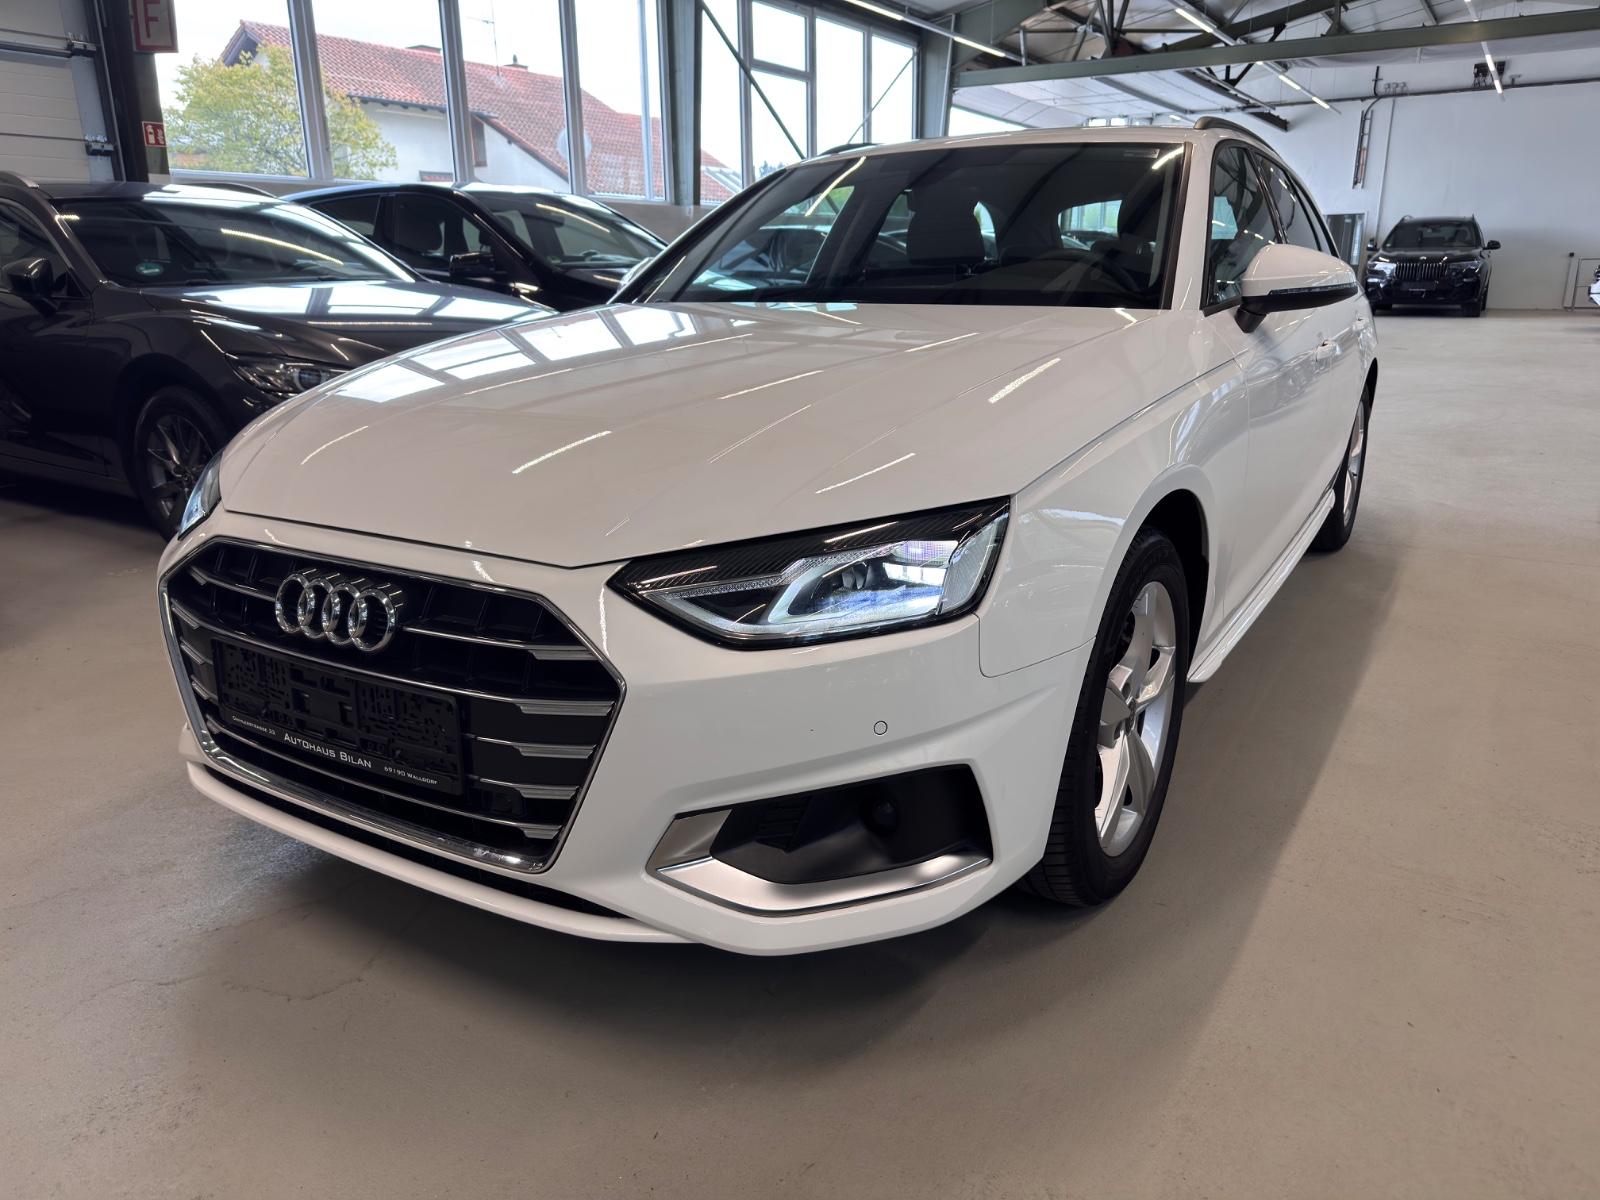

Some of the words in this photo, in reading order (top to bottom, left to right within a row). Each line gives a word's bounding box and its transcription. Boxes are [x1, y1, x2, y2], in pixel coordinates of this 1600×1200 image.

[283, 732, 337, 758] AUTOHAUS
[340, 751, 372, 769] BILAN
[383, 766, 406, 777] 69190
